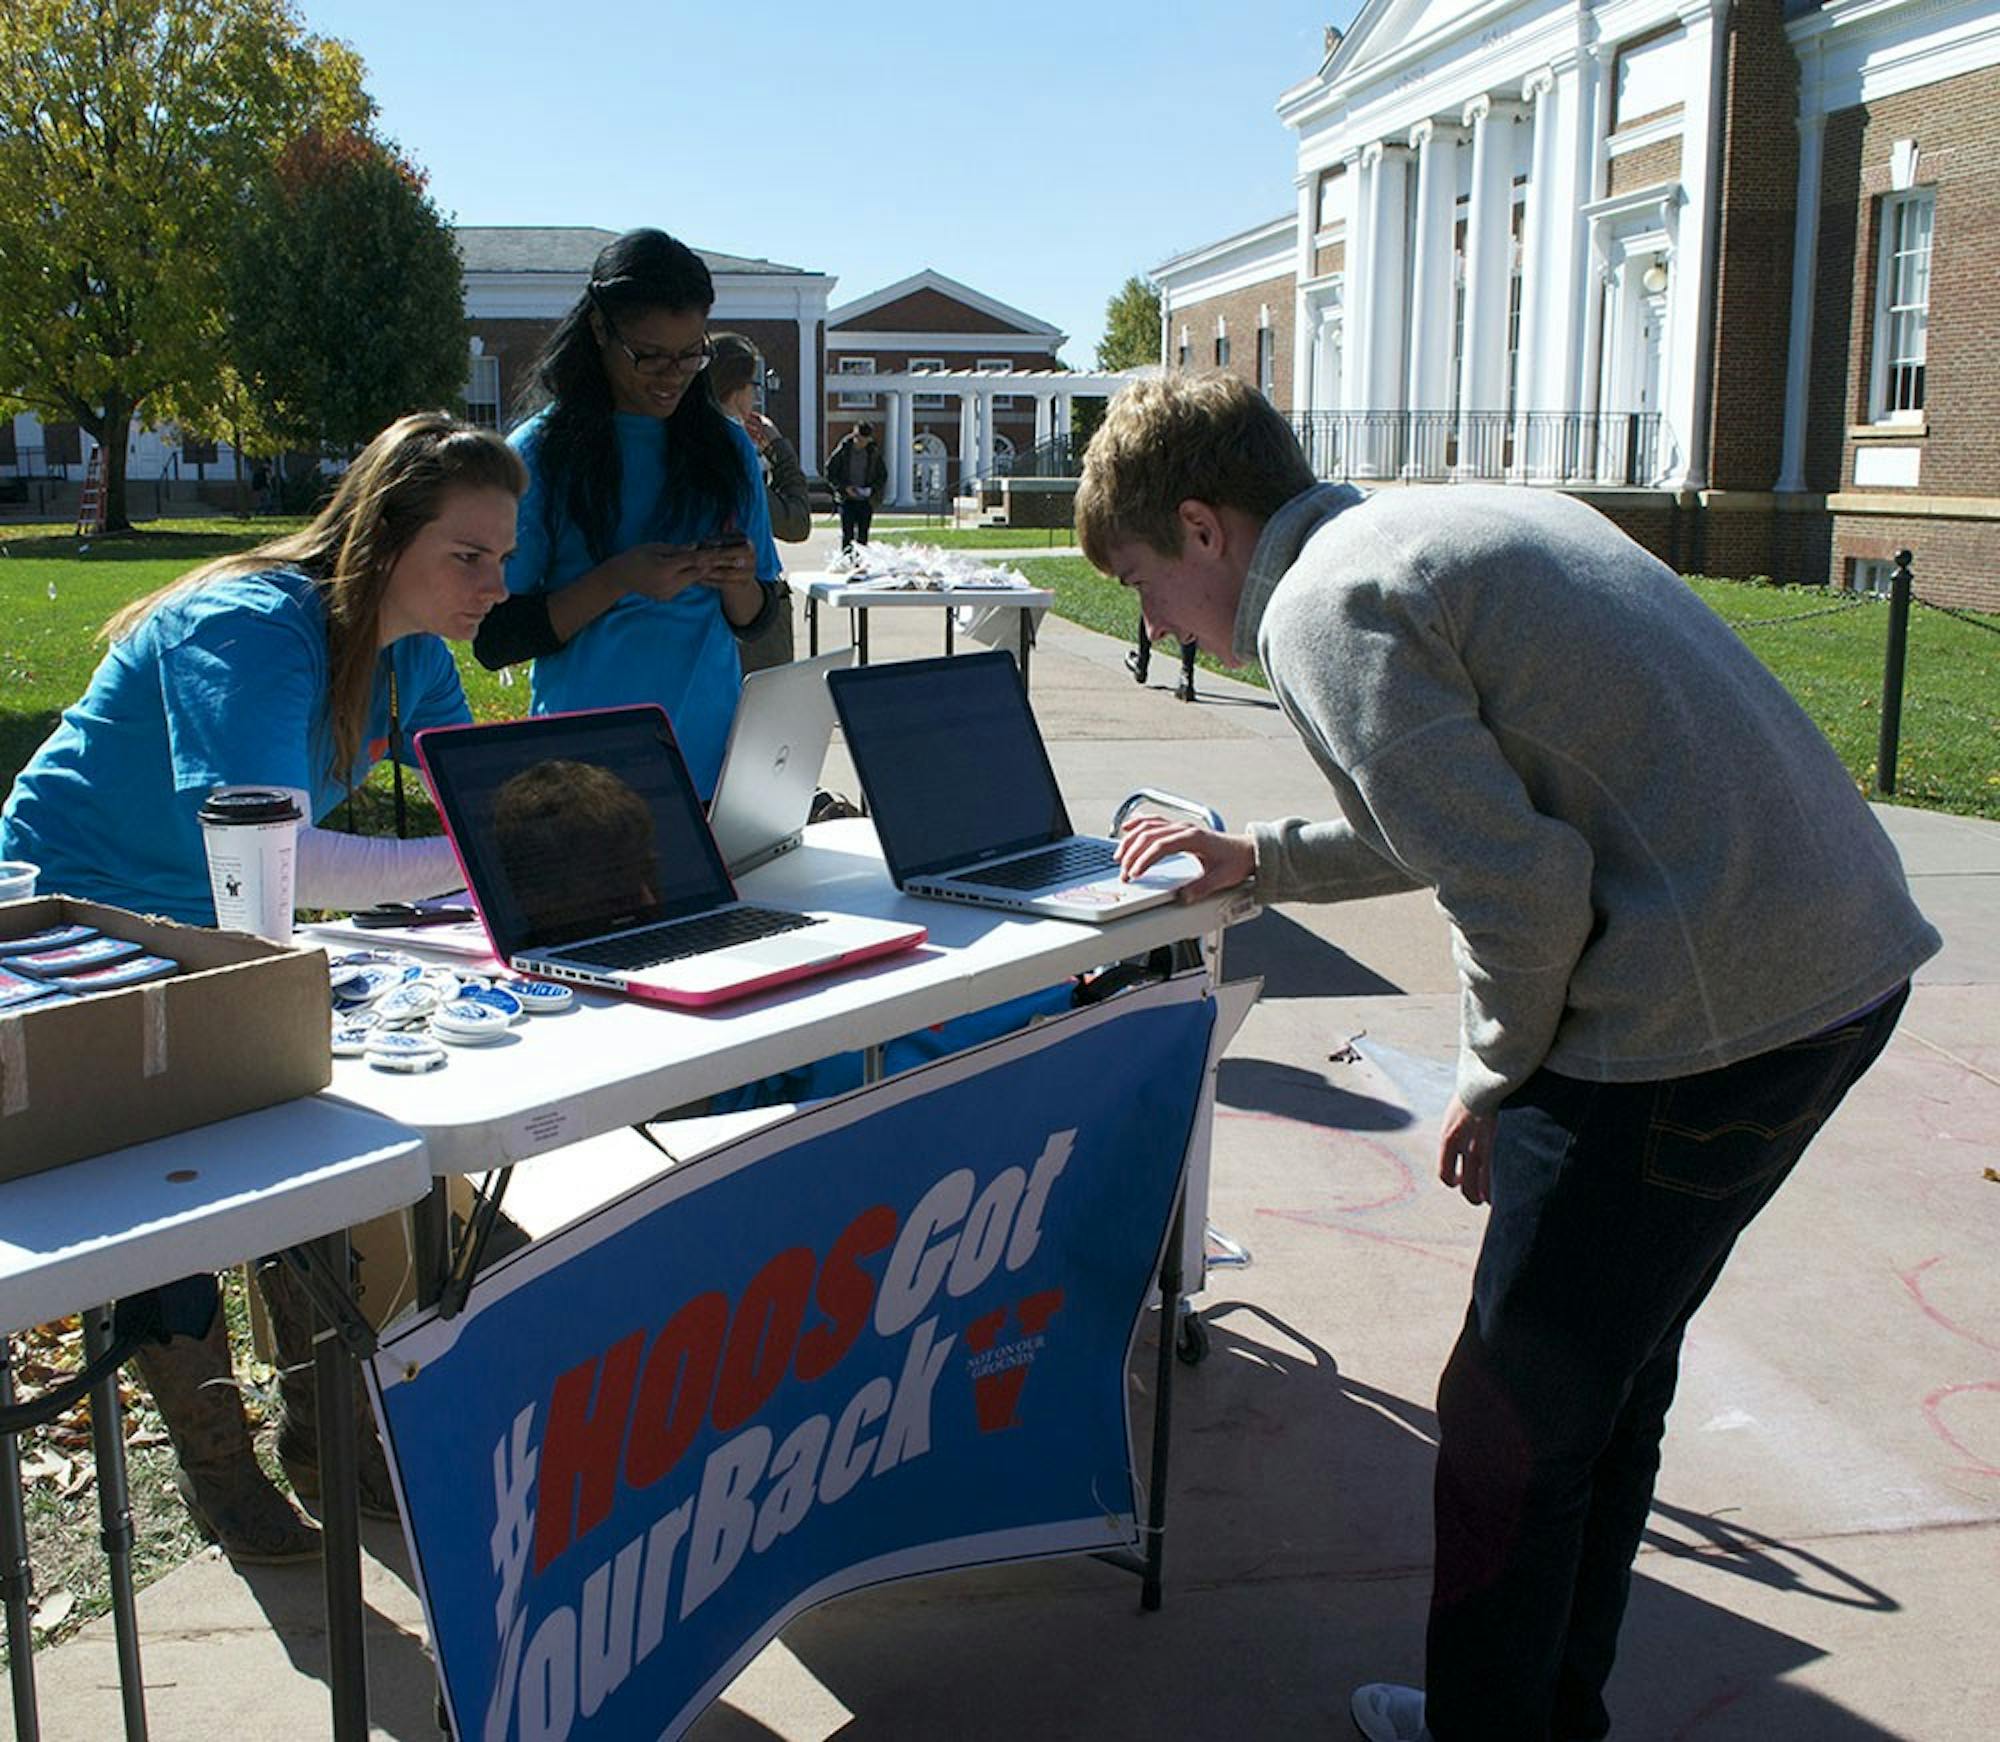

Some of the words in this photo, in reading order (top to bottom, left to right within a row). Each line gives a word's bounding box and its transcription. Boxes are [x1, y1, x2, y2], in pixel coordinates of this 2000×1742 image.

[966, 1350, 993, 1371] NOT
[1015, 1334, 1046, 1353] OUR
[970, 1352, 1035, 1380] GROUNDS
